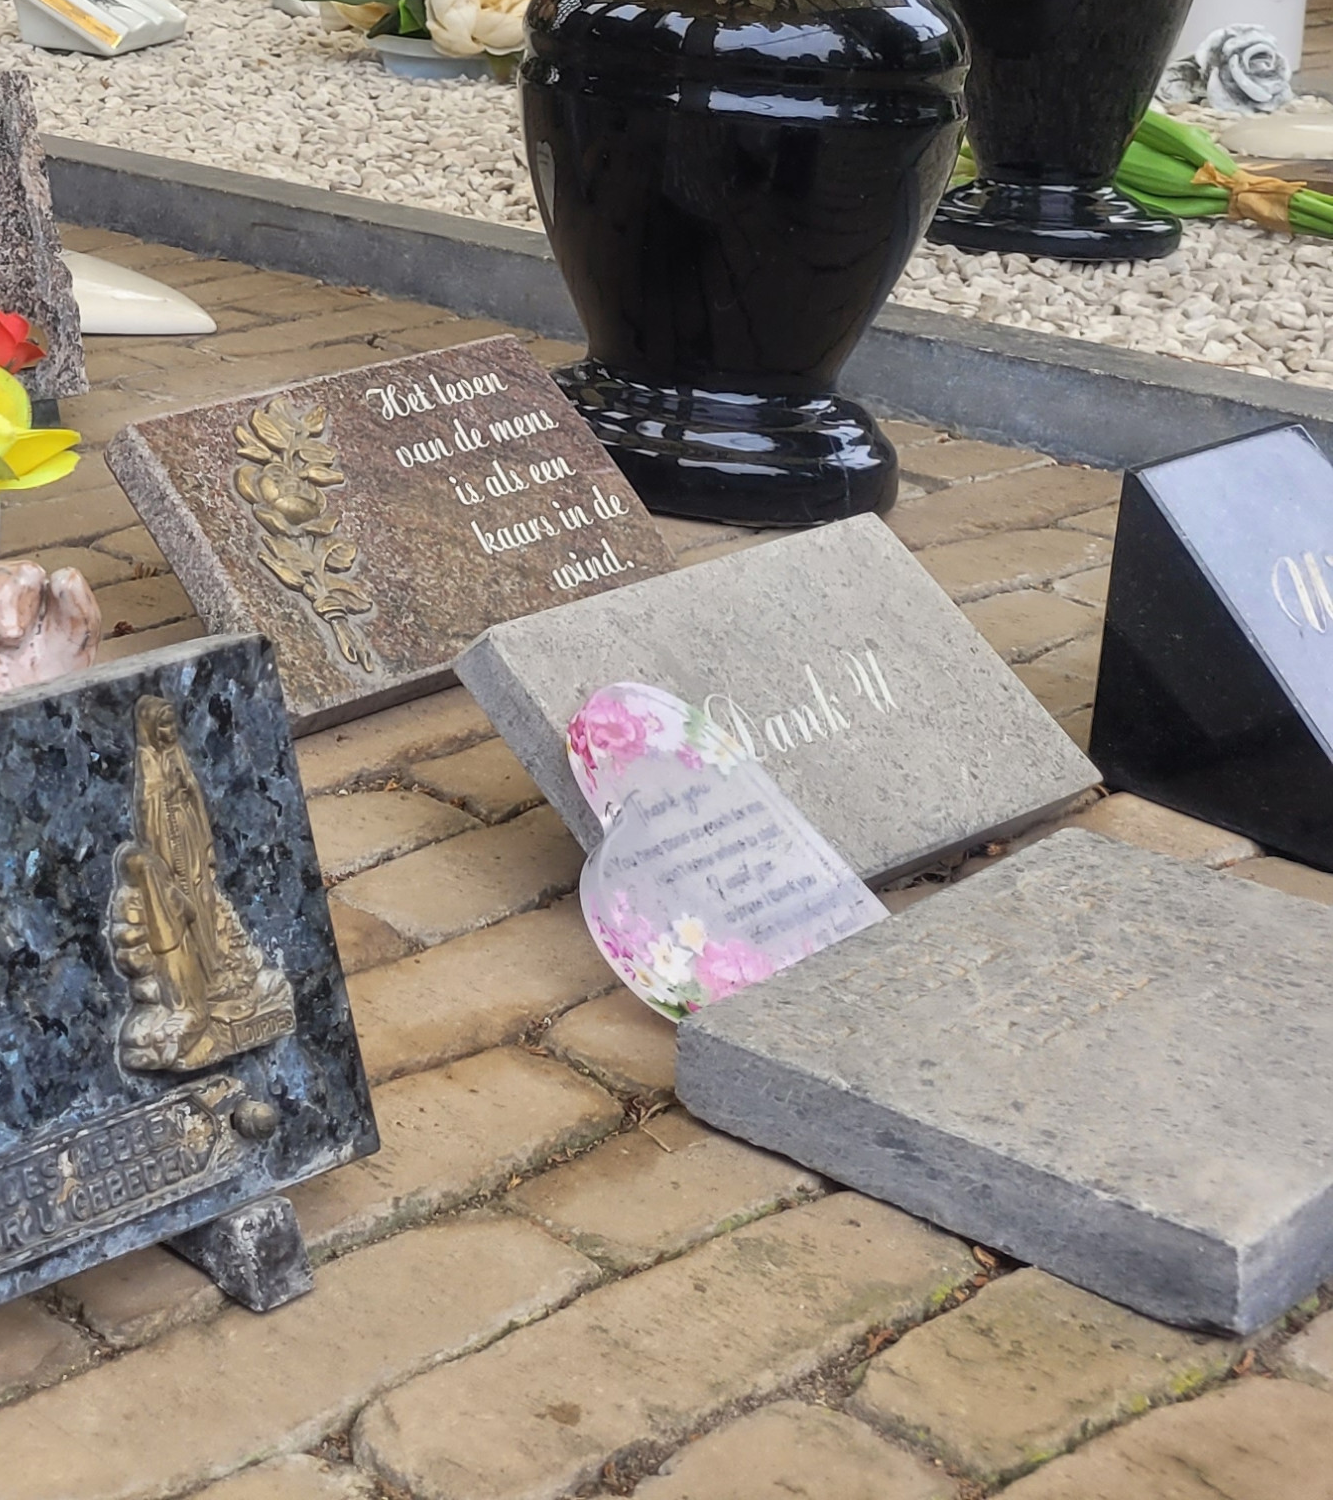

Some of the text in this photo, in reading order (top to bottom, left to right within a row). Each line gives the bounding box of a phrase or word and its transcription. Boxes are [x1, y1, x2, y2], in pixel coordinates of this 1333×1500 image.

[366, 372, 508, 420] Het leven
[396, 409, 559, 468] van de mens
[449, 456, 576, 505] is als een
[471, 485, 629, 554] kaars in de
[552, 537, 634, 590] wind.
[704, 664, 851, 761] Dank
